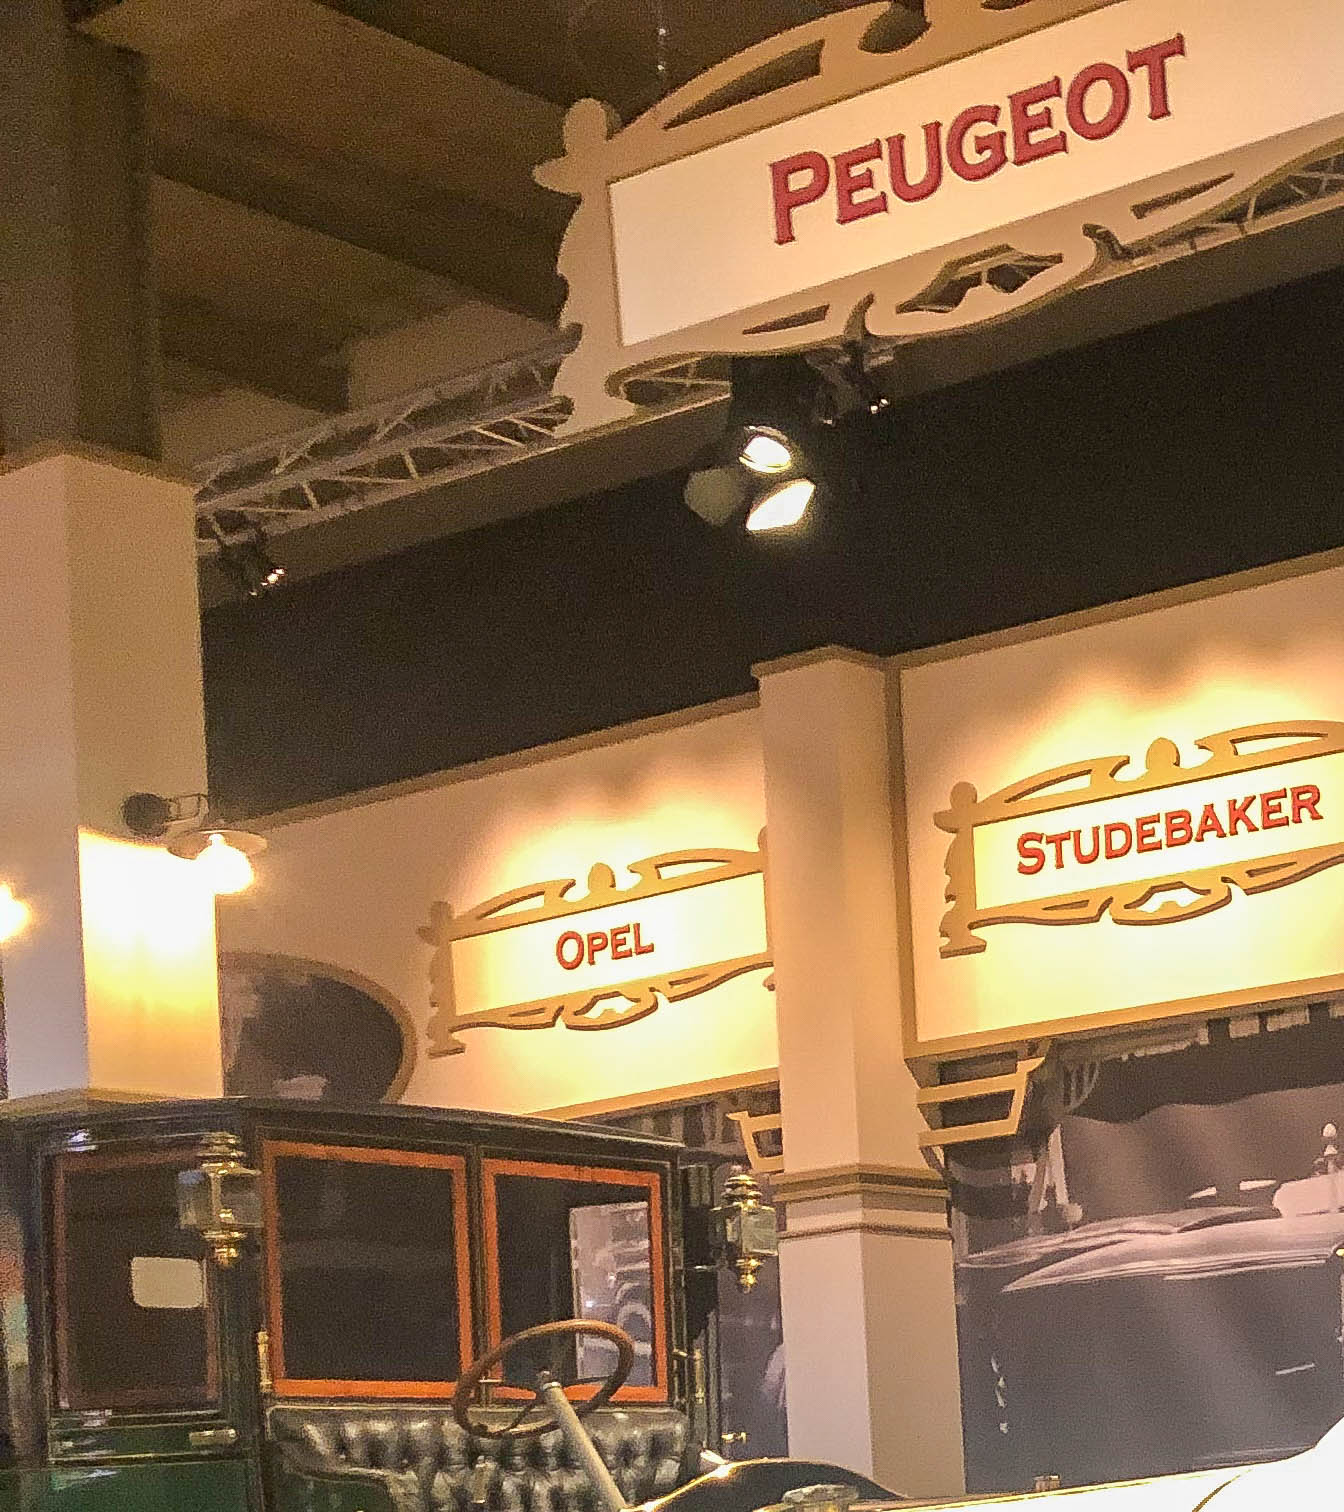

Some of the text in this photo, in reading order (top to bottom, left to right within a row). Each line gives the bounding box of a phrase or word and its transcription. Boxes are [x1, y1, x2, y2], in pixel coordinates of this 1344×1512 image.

[770, 34, 1186, 245] PEUGEOT
[1018, 785, 1322, 874] STUDEBAKER
[556, 923, 654, 971] OPEL
